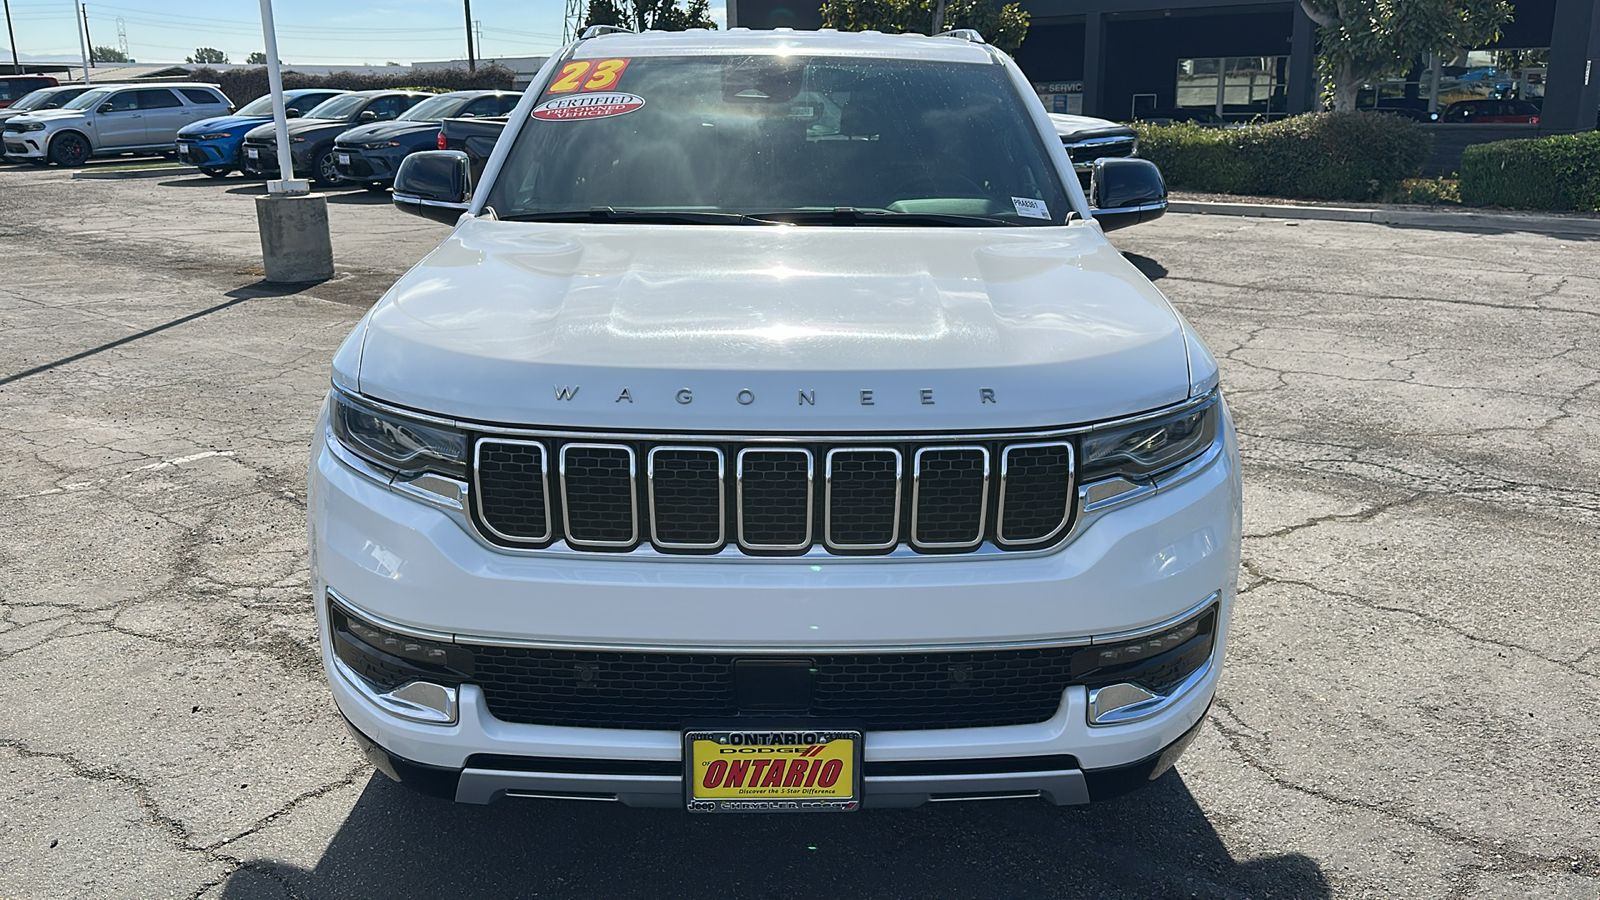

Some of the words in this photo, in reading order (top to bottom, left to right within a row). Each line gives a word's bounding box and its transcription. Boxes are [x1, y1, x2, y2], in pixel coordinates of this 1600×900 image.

[549, 59, 625, 93] 23
[1049, 83, 1082, 92] SERVIC
[546, 96, 634, 110] CERTIFIED
[546, 105, 626, 116] PRE-OWNED
[557, 109, 612, 119] VEHICLE
[553, 384, 997, 406] WAGONEER
[729, 732, 818, 746] ONTARIO
[702, 758, 844, 789] ONTARIO
[687, 801, 717, 812] Jeep
[721, 802, 799, 810] CHRYSLER
